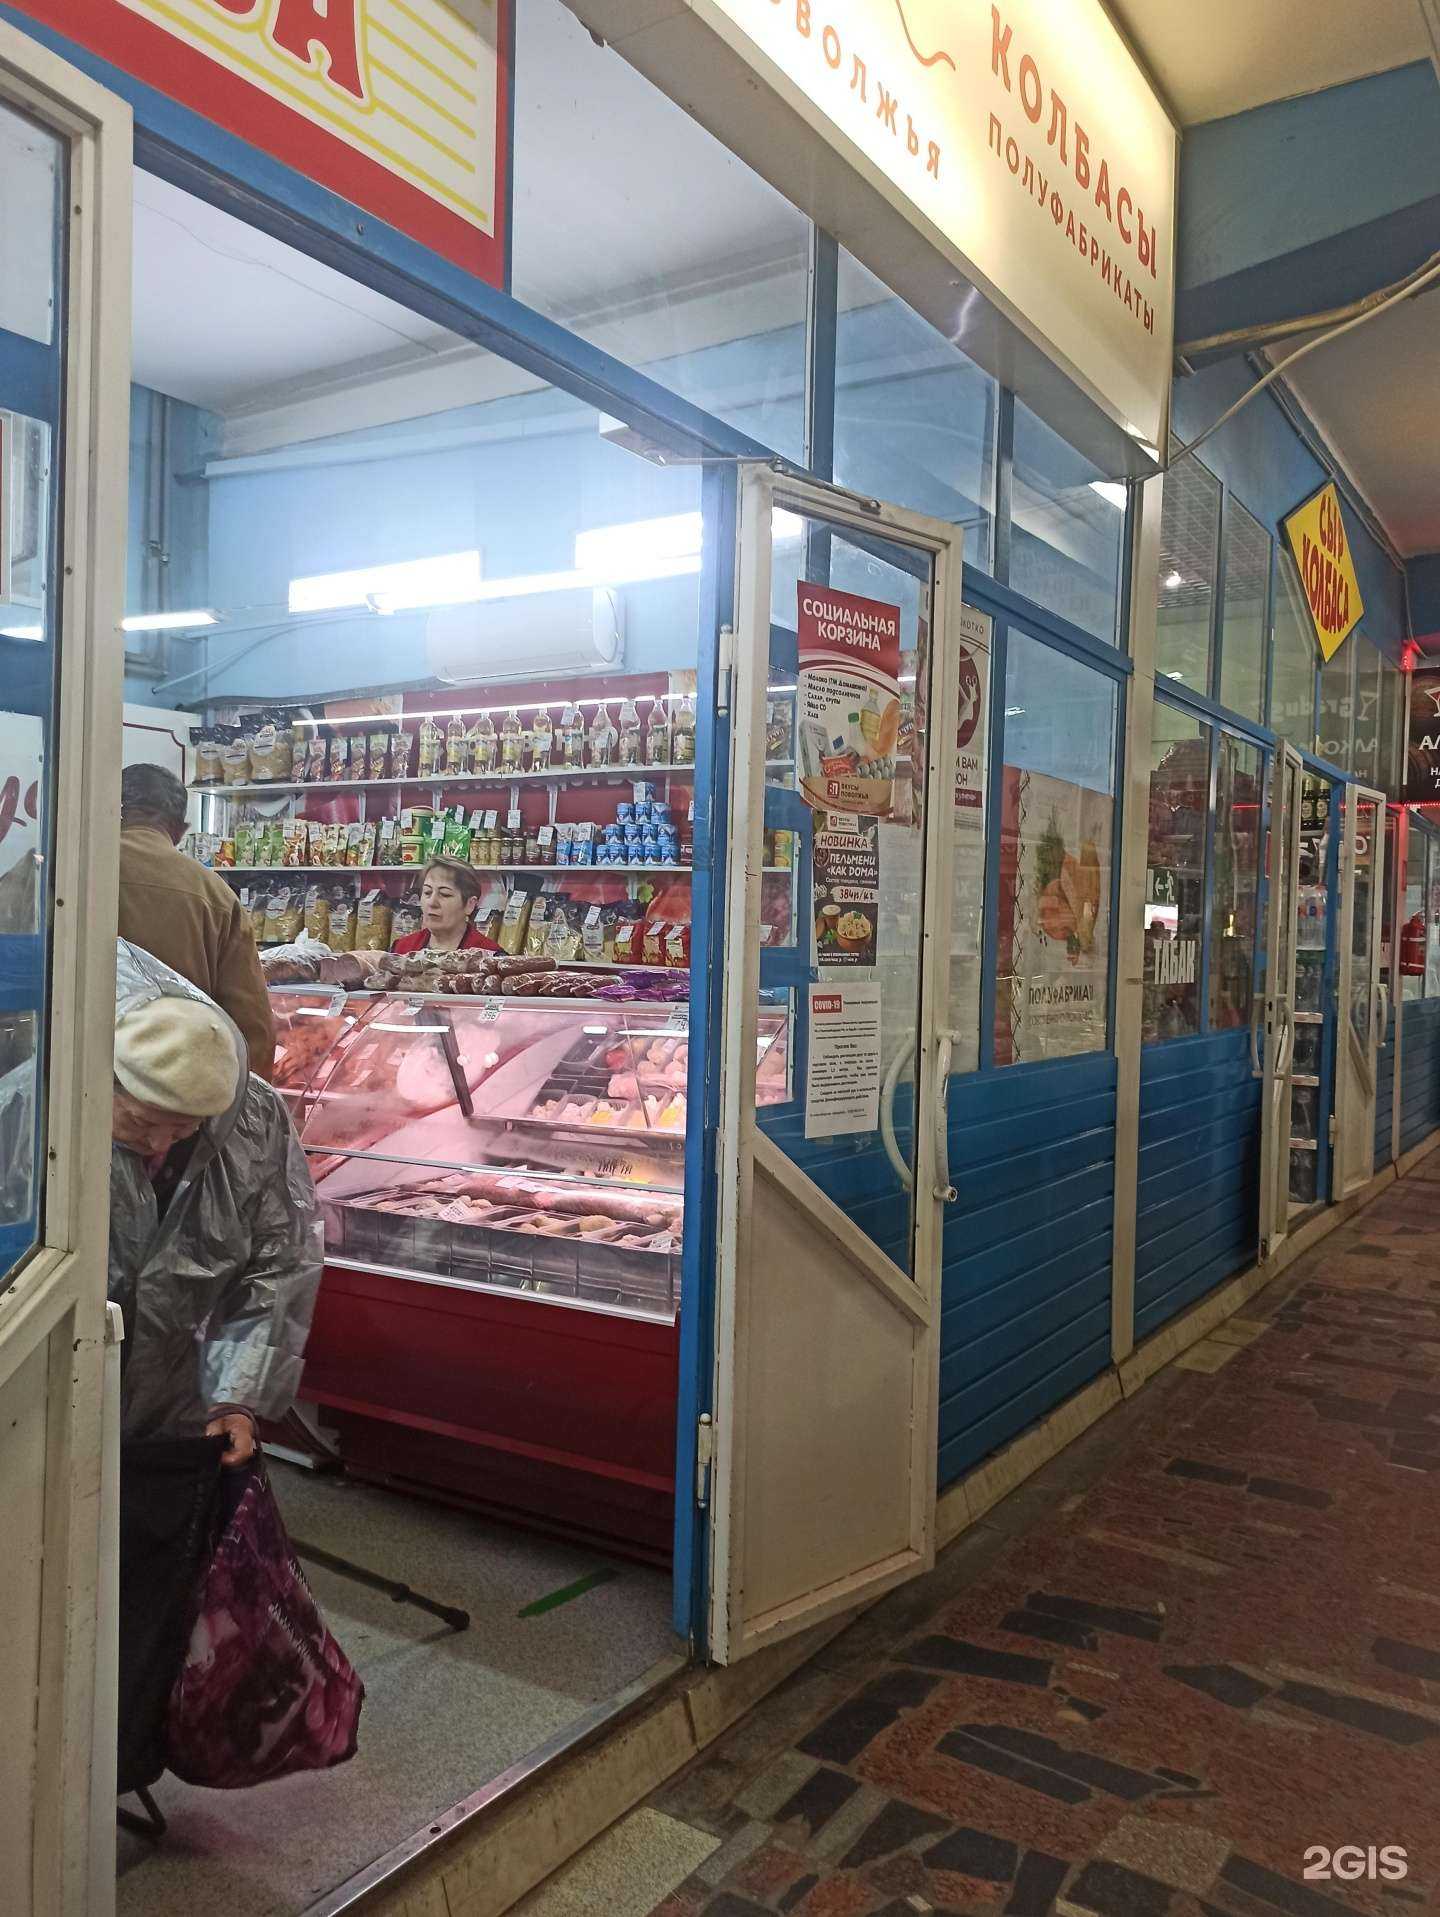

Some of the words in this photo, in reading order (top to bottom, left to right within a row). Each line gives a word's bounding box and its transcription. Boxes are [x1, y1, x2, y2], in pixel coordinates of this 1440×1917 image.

[769, 0, 941, 180] ВОЛЖЬЯ
[991, 4, 1157, 279] КОЛБАСЫ
[989, 112, 1154, 335] ПОЛУФАБРИКАТЫ
[1320, 494, 1344, 564] СЫР
[1302, 534, 1349, 634] КОЛБАСА
[803, 598, 895, 636] СОЦИАЛЬНАЯ
[818, 621, 880, 651] КОРЗИНА
[821, 835, 868, 849] НОВИНКА
[830, 853, 876, 866] ПЕЛЬМЕНИ
[826, 865, 847, 876] «КАК
[849, 867, 878, 877] ДОМА»
[1153, 939, 1196, 985] ТАБАК
[814, 1000, 841, 1010] COVID-19
